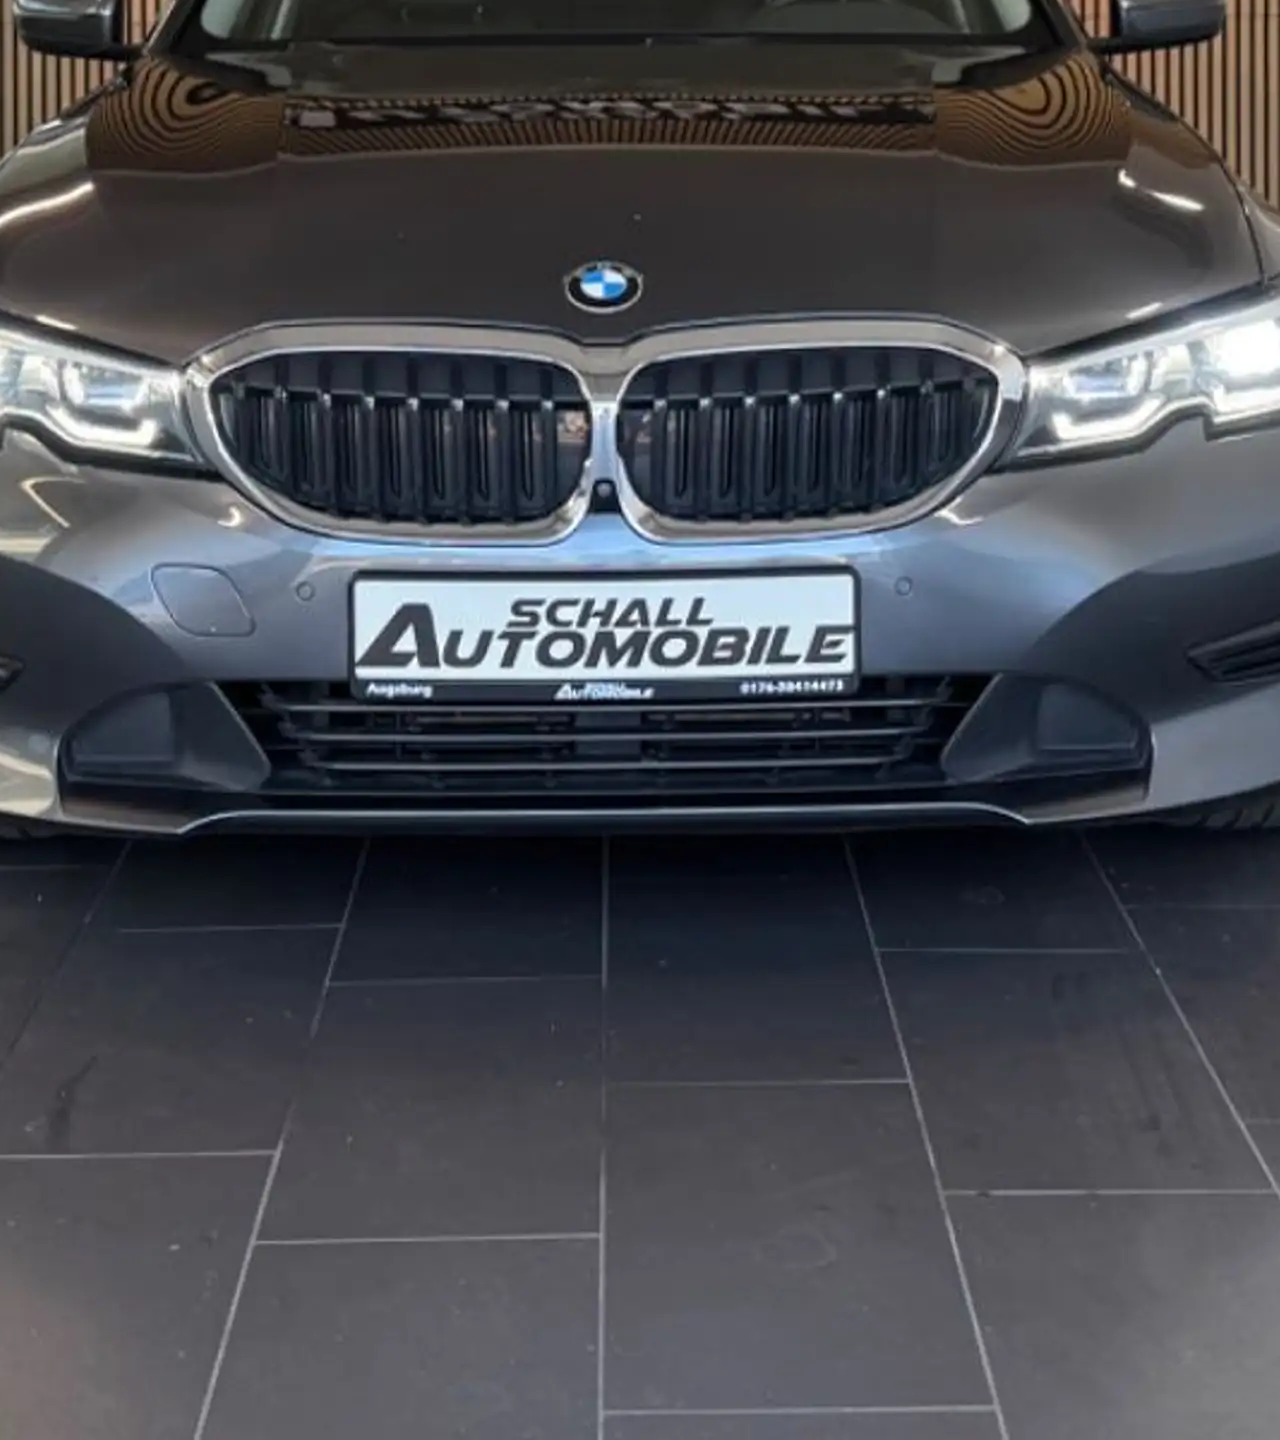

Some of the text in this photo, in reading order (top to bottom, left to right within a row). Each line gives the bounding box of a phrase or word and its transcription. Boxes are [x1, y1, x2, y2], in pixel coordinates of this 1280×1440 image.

[506, 597, 714, 628] SCHALL
[355, 602, 856, 669] AUTOMOBILE
[366, 682, 433, 699] Augsburg
